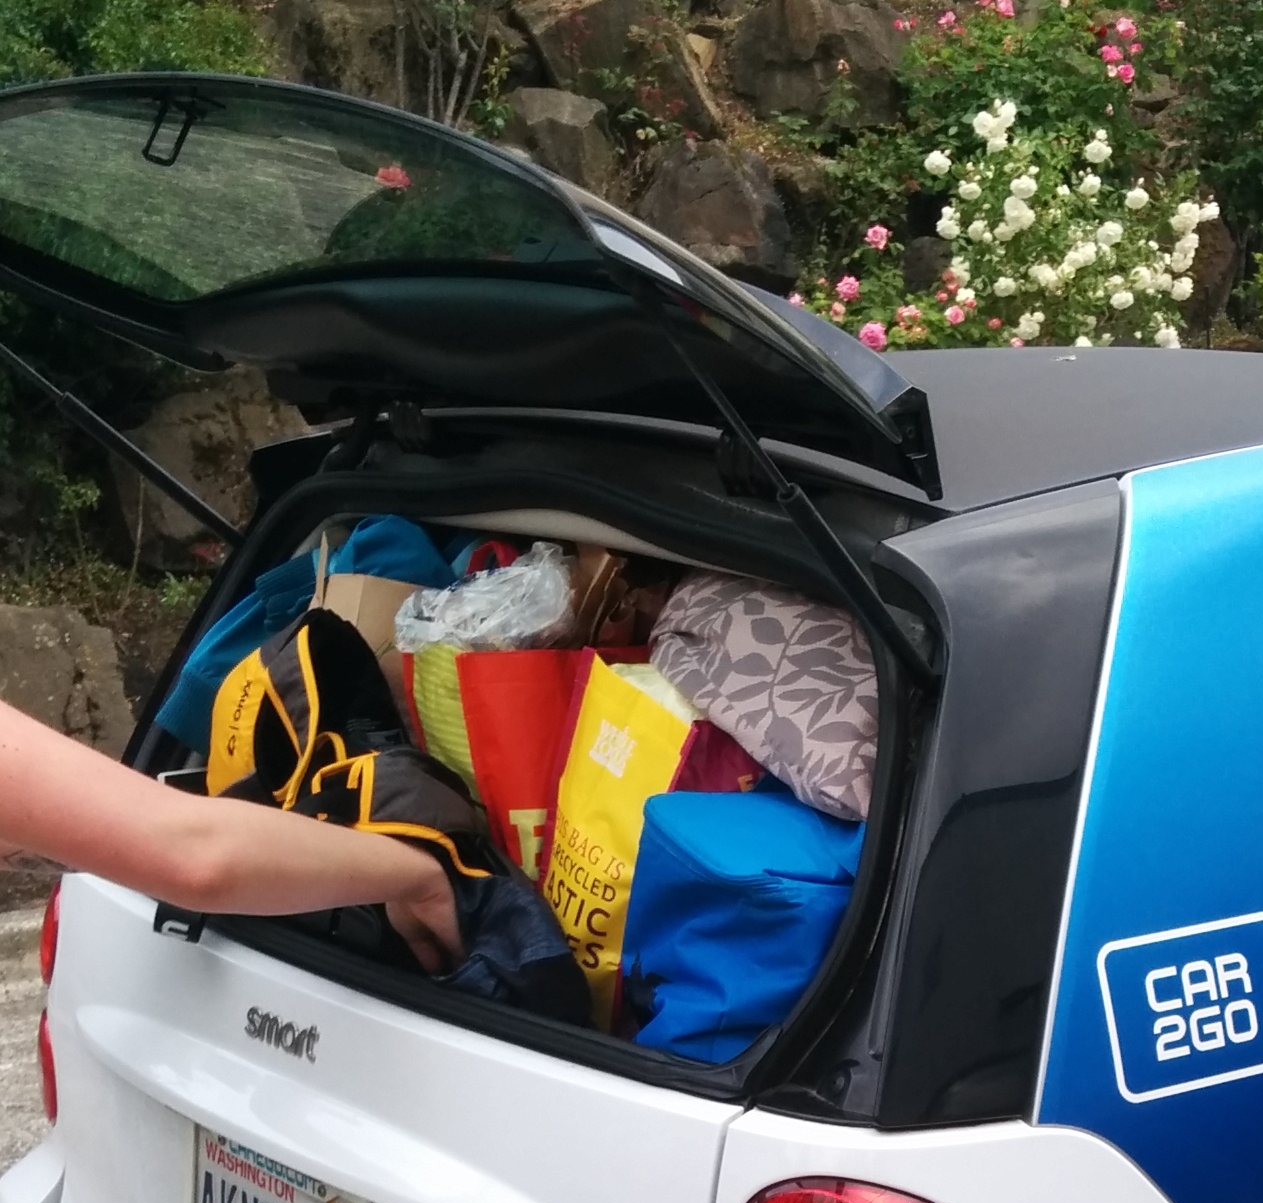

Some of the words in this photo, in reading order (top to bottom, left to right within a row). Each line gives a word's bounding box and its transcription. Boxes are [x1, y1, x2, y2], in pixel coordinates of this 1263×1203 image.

[568, 827, 604, 866] BAG
[603, 855, 626, 881] IS
[1145, 953, 1252, 1012] CAR
[244, 1005, 320, 1063] smart
[1153, 999, 1258, 1061] 2GO
[205, 1138, 295, 1203] WASHINGTON
